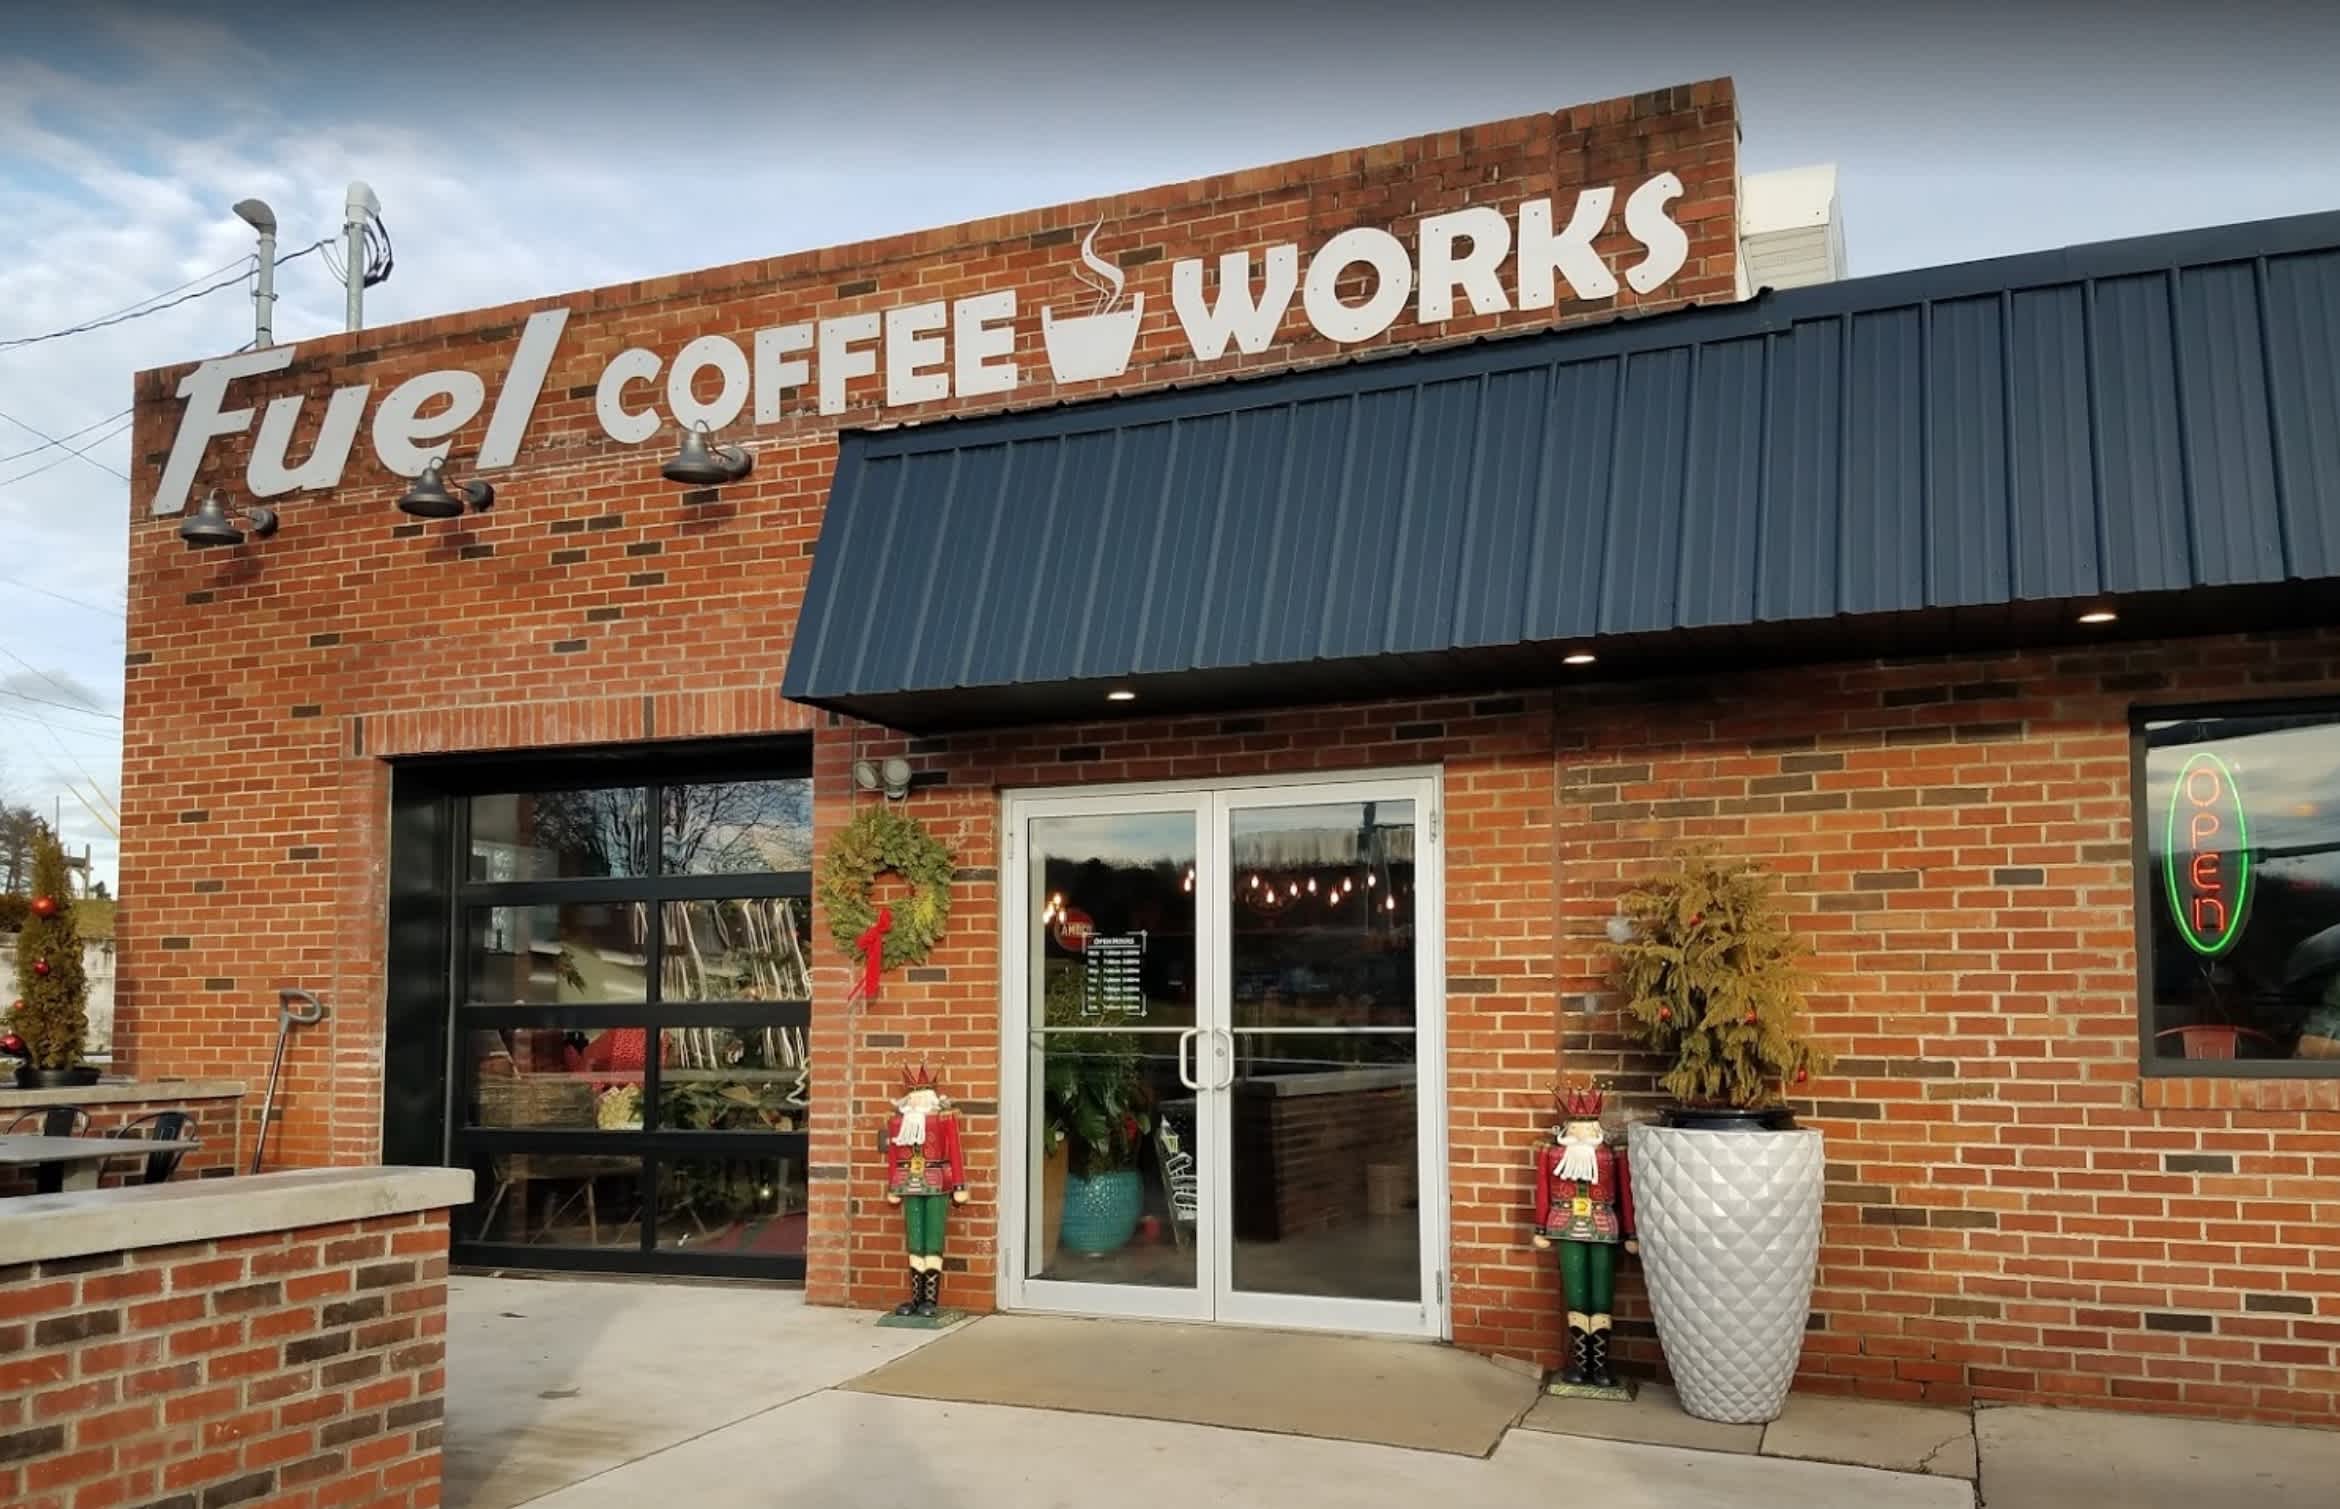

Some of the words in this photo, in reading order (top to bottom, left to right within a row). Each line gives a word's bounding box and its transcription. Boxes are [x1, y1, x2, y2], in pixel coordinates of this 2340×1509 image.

[151, 307, 571, 517] Fuel
[597, 290, 1020, 444] COFFEE
[1172, 170, 1690, 361] WORKS
